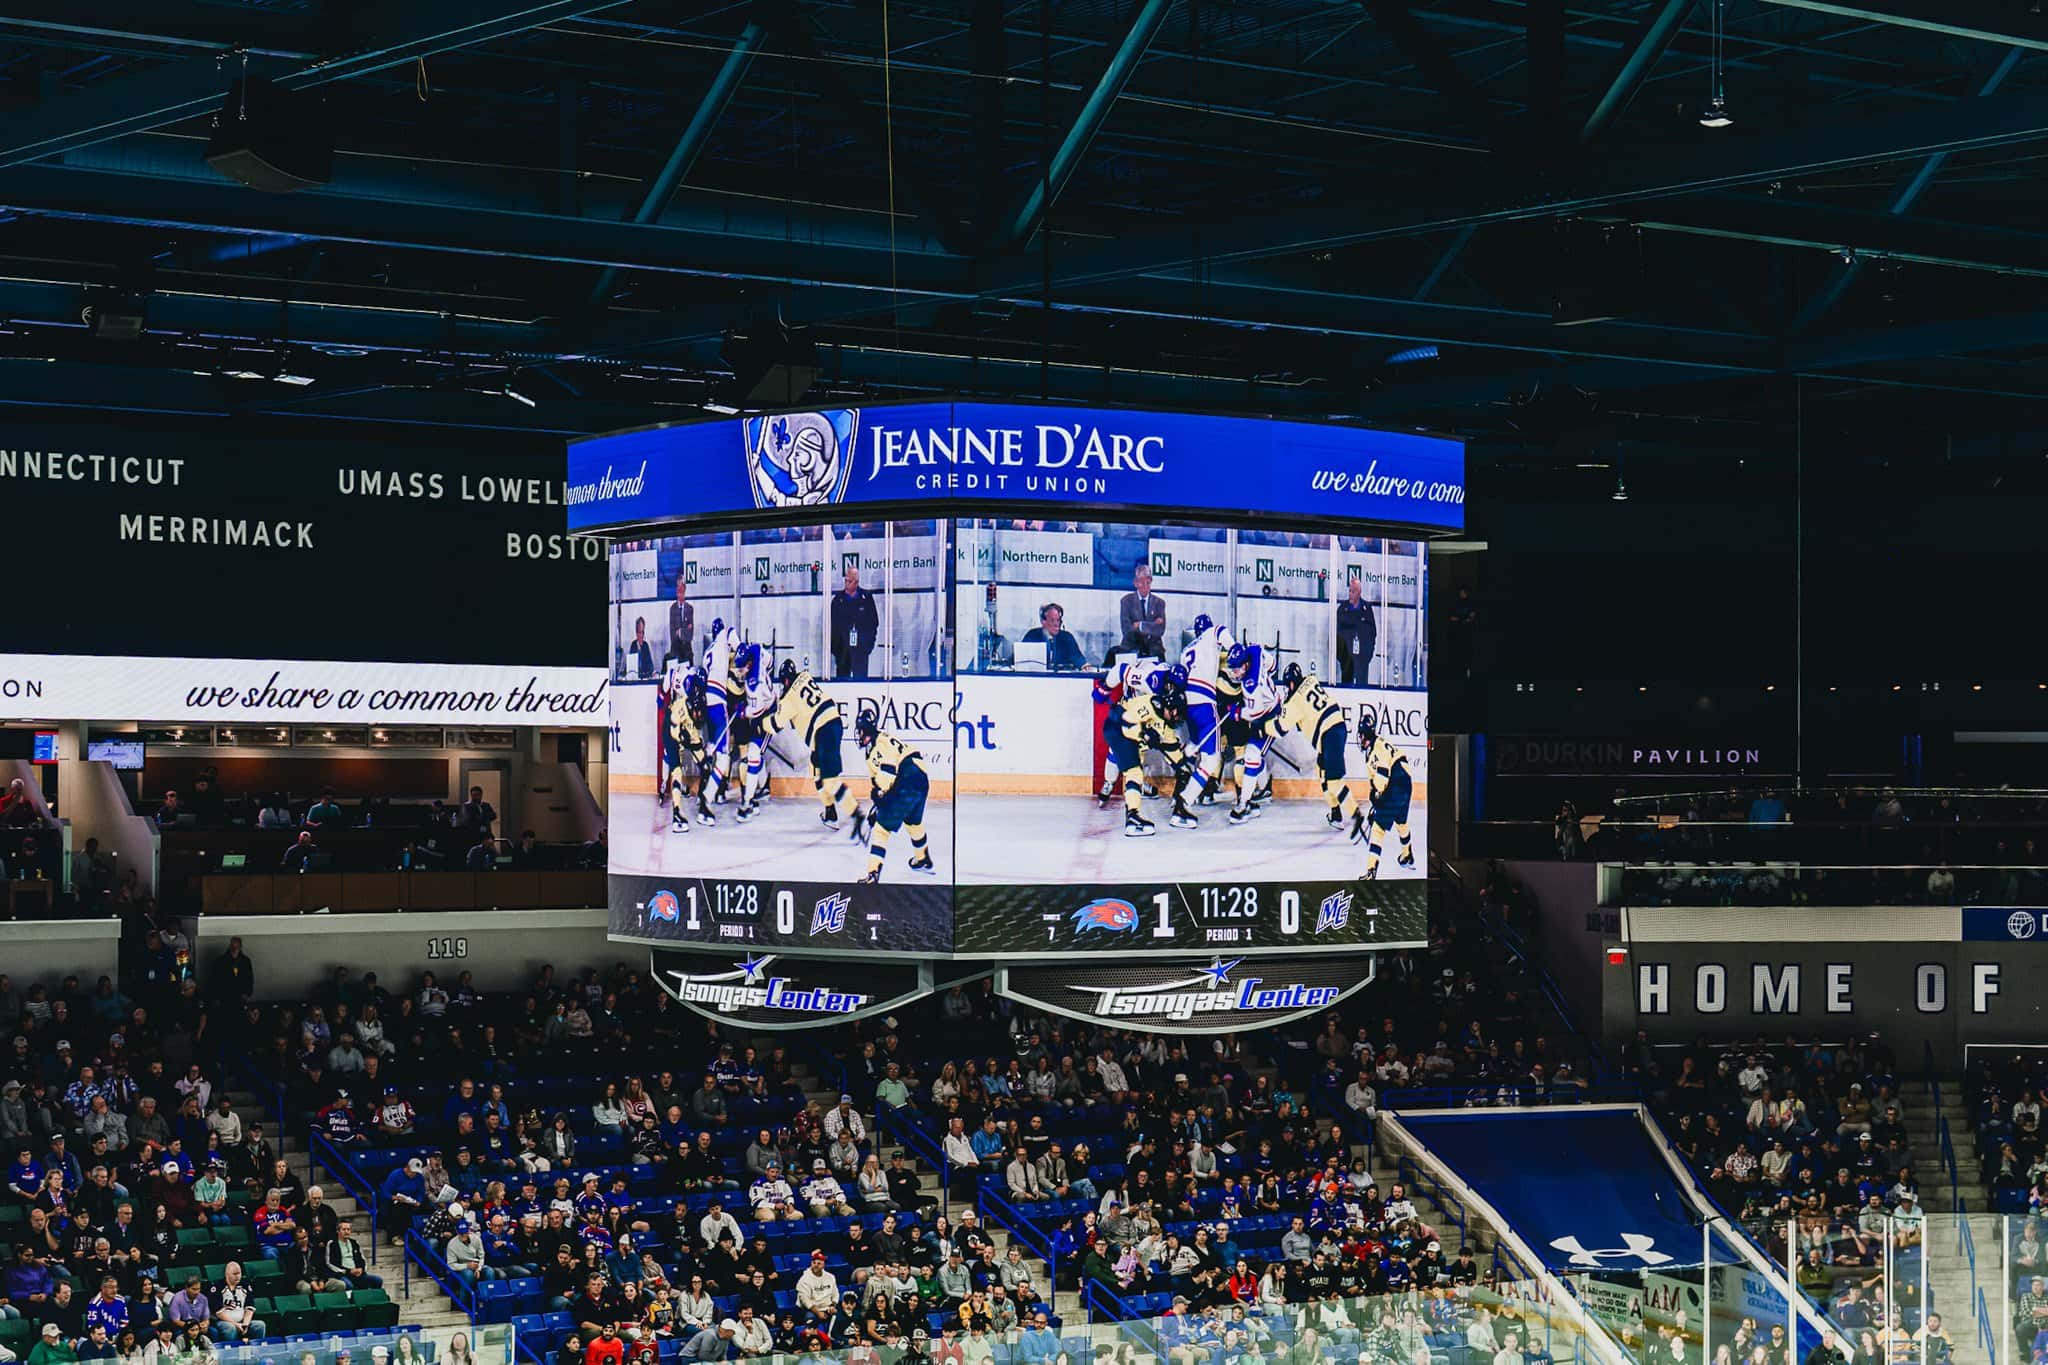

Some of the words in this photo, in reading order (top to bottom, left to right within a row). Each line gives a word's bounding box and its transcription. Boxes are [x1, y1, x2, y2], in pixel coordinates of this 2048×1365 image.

[869, 426, 1023, 481] JEANNE
[1035, 424, 1164, 472] D'ARC
[339, 469, 443, 498] UMASS
[598, 460, 647, 500] thread
[916, 475, 1008, 489] CREDIT
[1027, 477, 1106, 493] UNION
[1312, 470, 1349, 491] we
[1351, 460, 1409, 496] share
[1411, 480, 1426, 499] a
[120, 514, 314, 548] MERRIMACK
[774, 562, 811, 573] Northern
[1002, 550, 1057, 563] Northern
[1060, 552, 1089, 564] Bank
[1177, 560, 1224, 572] Northern
[700, 565, 731, 577] Northern
[1278, 566, 1319, 579] Northern
[185, 687, 239, 708] we
[241, 671, 335, 708] share
[337, 689, 364, 710] a
[368, 688, 502, 711] common
[505, 677, 608, 713] thread
[1525, 743, 1622, 762] DURKIN
[1632, 749, 1760, 763] PAVILION
[686, 887, 700, 930] 1
[715, 884, 758, 915] 11:28
[777, 890, 794, 934] 0
[1153, 892, 1175, 938] 1
[1200, 887, 1258, 918] 11:28
[1280, 890, 1299, 934] 0
[719, 924, 744, 937] PERIOD
[748, 926, 754, 938] 1
[870, 926, 878, 940] 1
[1047, 926, 1056, 941] 7
[1206, 928, 1239, 941] PERIOD
[1245, 928, 1252, 940] 1
[1368, 920, 1376, 934] 1
[428, 937, 468, 959] 119
[670, 971, 767, 1012] Tsongas
[764, 976, 868, 1013] Center
[1636, 962, 1854, 1014] HOME
[1915, 962, 2000, 1014] OF
[1080, 984, 1237, 1021] Tsongas
[1234, 978, 1340, 1010] Center
